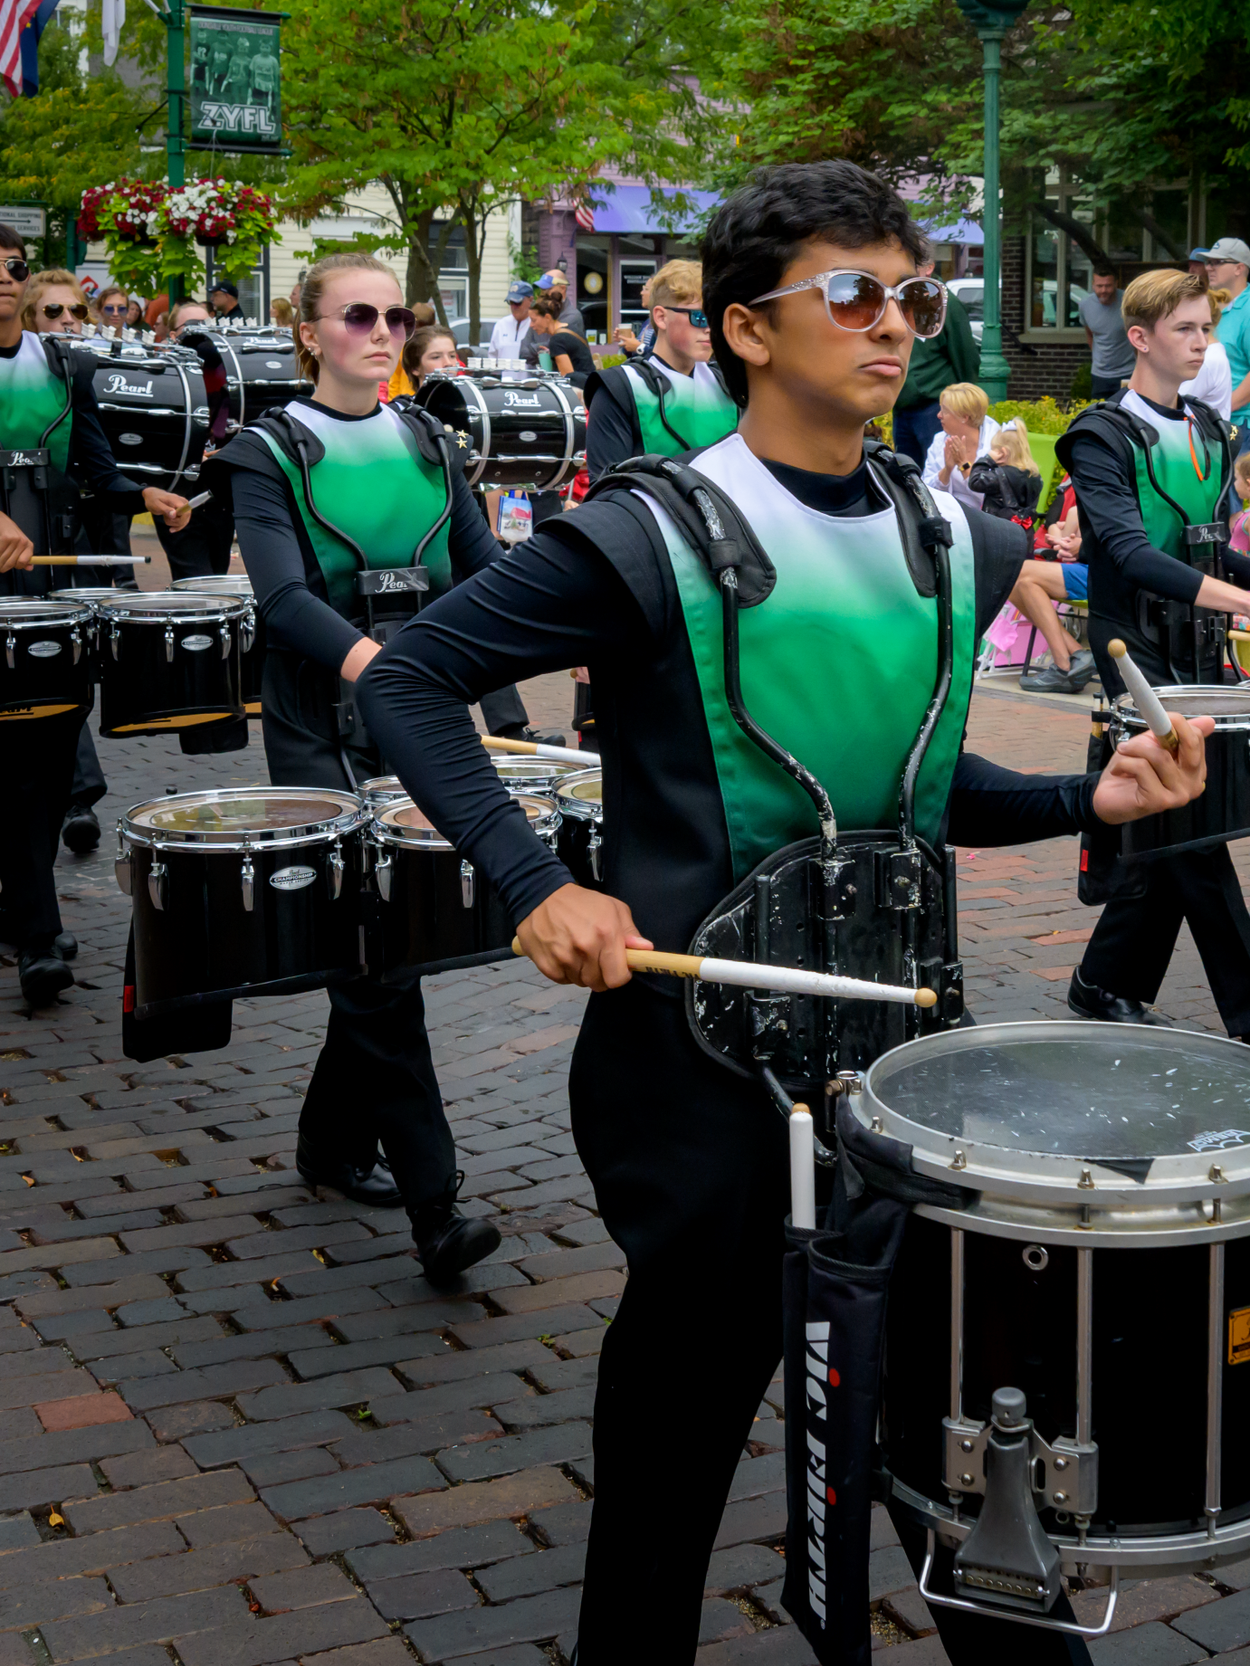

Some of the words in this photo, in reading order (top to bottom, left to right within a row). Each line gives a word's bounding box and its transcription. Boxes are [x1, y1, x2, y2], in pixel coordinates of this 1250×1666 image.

[198, 101, 276, 134] ZYFL
[103, 374, 154, 398] Pearl
[504, 391, 542, 407] Pearl
[374, 571, 409, 594] Pea
[805, 1321, 841, 1421] VIC
[806, 1428, 837, 1621] FIRTH
